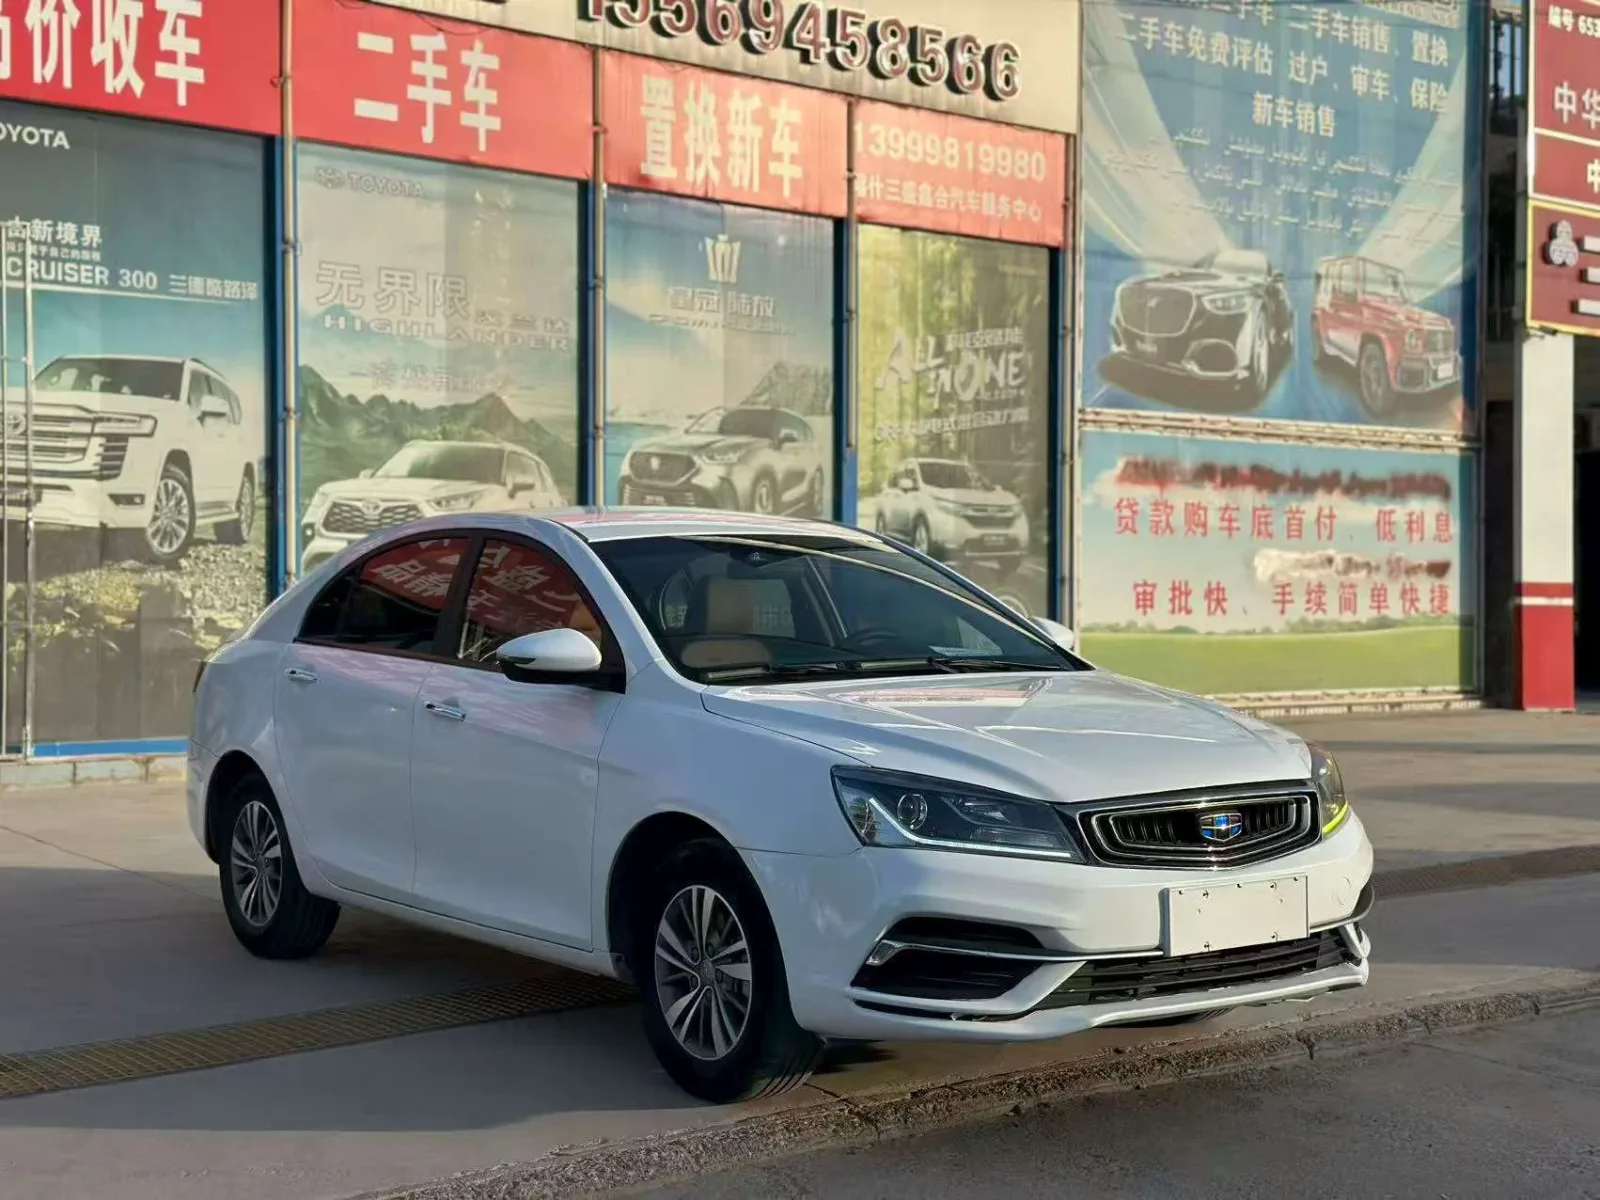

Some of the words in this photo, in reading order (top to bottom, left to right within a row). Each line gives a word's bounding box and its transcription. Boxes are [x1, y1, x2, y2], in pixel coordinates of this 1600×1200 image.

[354, 32, 501, 152] 二手车
[1252, 90, 1336, 138] 新车销售
[639, 75, 803, 198] 置换新车
[854, 120, 1047, 183] 13999819980
[347, 173, 425, 199] TOYOTA
[6, 256, 110, 286] CRUISER
[117, 268, 158, 291] 300
[315, 260, 471, 319] 无界限
[323, 314, 571, 351] HIGHLANDER
